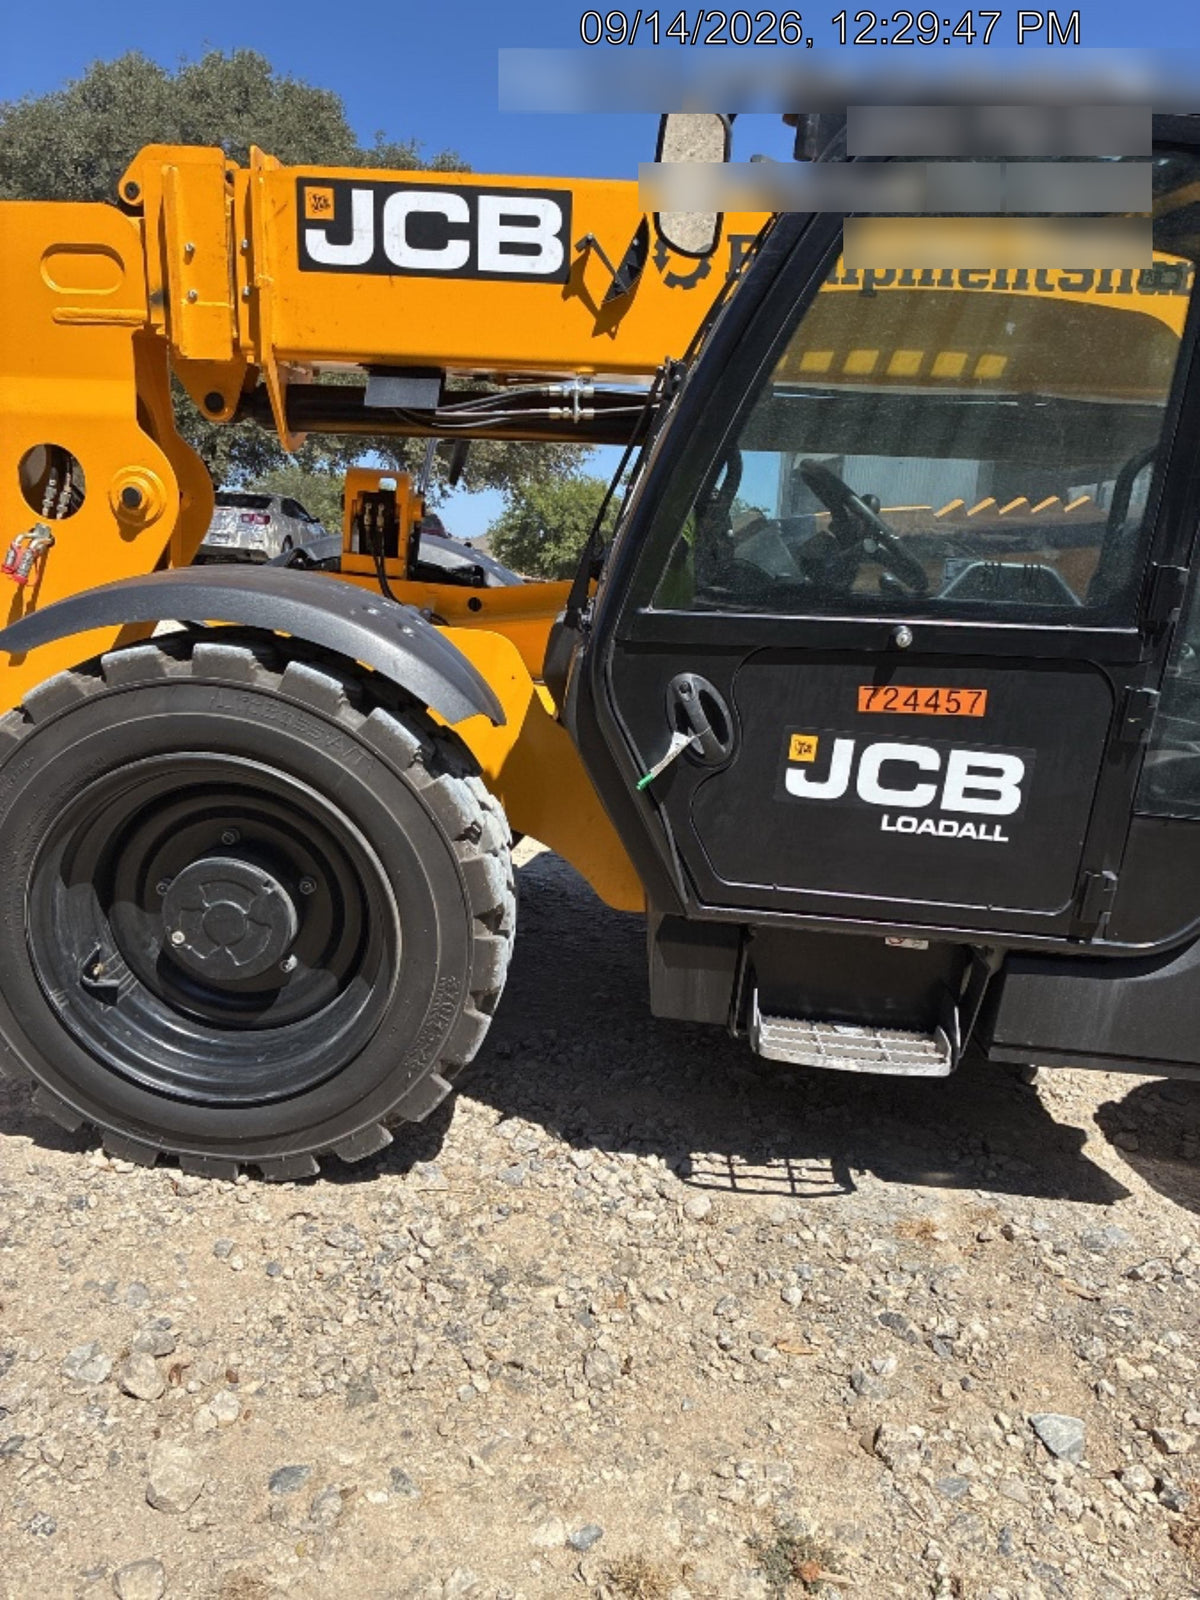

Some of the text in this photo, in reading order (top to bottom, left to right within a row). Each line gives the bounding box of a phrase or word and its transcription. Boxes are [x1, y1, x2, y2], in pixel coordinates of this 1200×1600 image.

[305, 188, 564, 275] JCB
[862, 687, 983, 715] 724457
[785, 738, 1025, 816] JCB
[880, 814, 1009, 842] LOADALL
